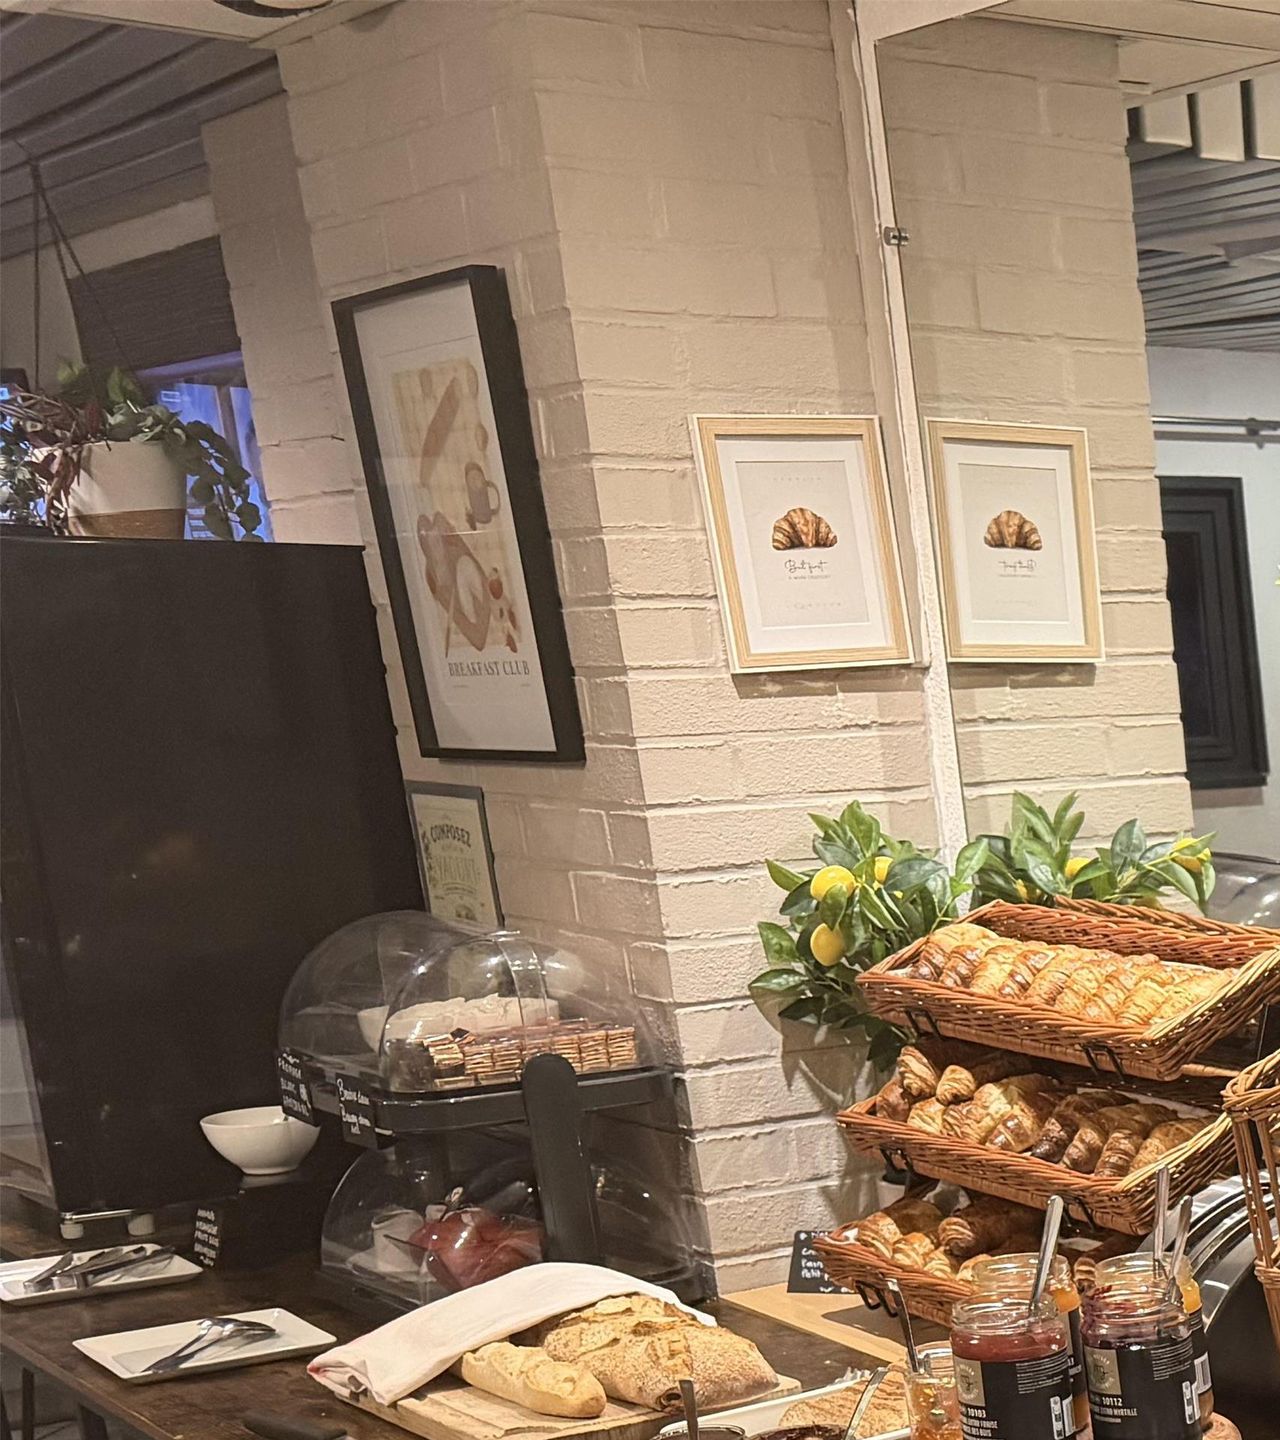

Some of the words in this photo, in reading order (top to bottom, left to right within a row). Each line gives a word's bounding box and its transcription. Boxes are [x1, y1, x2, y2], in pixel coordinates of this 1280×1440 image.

[447, 661, 501, 677] BREAKFAST
[502, 660, 530, 676] CLUB
[430, 823, 472, 848] COMPOSEZ
